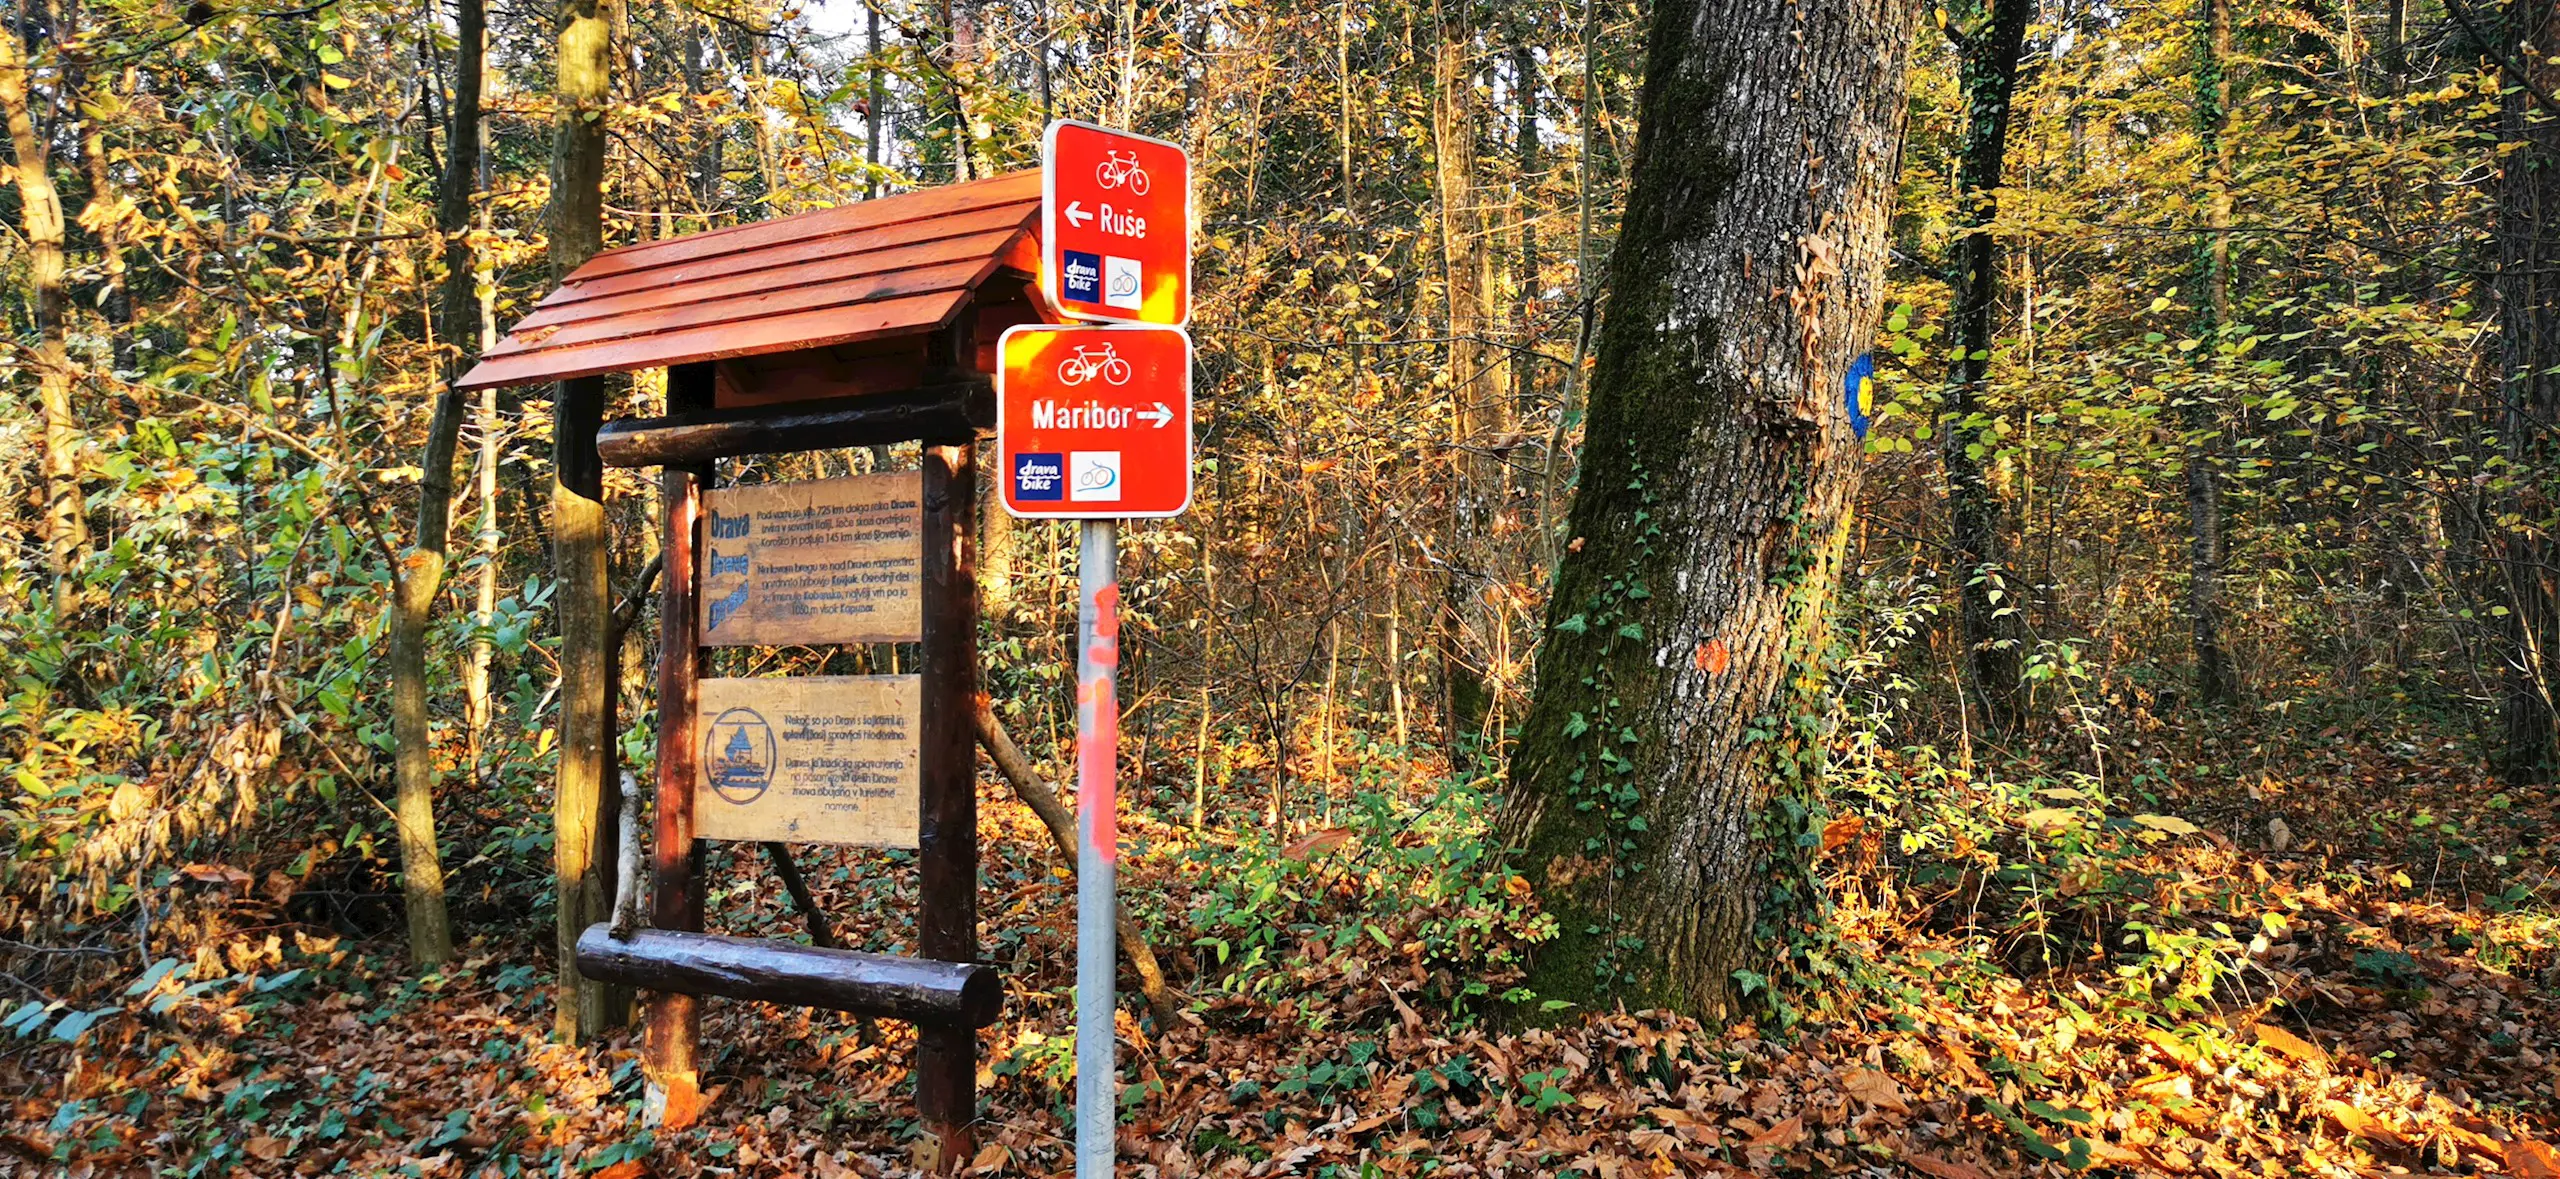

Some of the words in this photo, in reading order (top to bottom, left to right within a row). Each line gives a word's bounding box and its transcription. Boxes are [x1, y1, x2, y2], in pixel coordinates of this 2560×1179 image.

[1100, 202, 1146, 239] Ruše
[1066, 258, 1097, 277] drava
[1068, 275, 1092, 291] bike
[1032, 400, 1133, 429] Maribor
[1019, 459, 1058, 476] drava
[1021, 476, 1051, 490] bike
[711, 508, 749, 538] Drava
